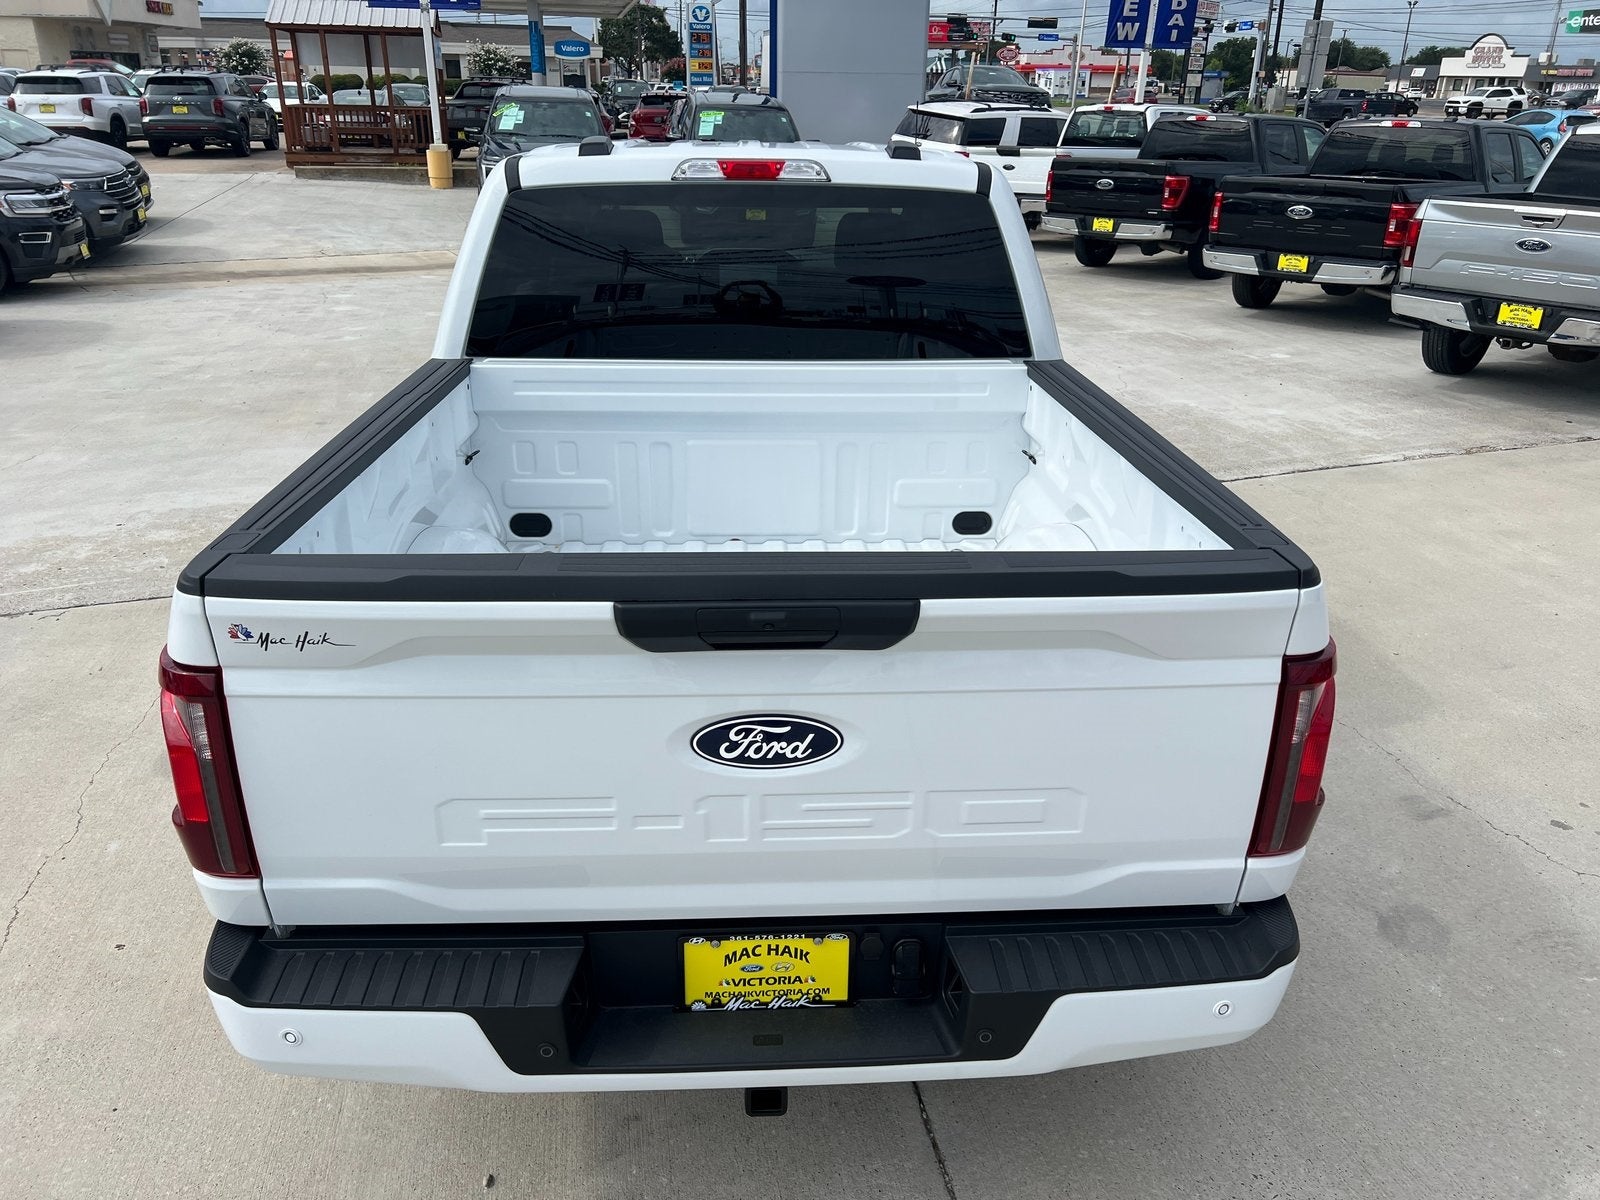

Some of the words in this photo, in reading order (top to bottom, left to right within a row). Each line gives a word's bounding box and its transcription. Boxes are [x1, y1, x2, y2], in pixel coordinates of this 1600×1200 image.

[561, 44, 584, 52] Valero
[253, 632, 289, 651] Mac
[295, 631, 335, 652] Haik
[719, 724, 816, 759] Ford
[434, 787, 1087, 847] F-150
[724, 944, 762, 967] MAC
[767, 944, 811, 964] HAIK
[730, 975, 804, 987] VICTORIA
[704, 987, 831, 999] MACHAIKVICTORIA.COM
[724, 997, 764, 1011] Mac
[767, 995, 813, 1010] Haik
